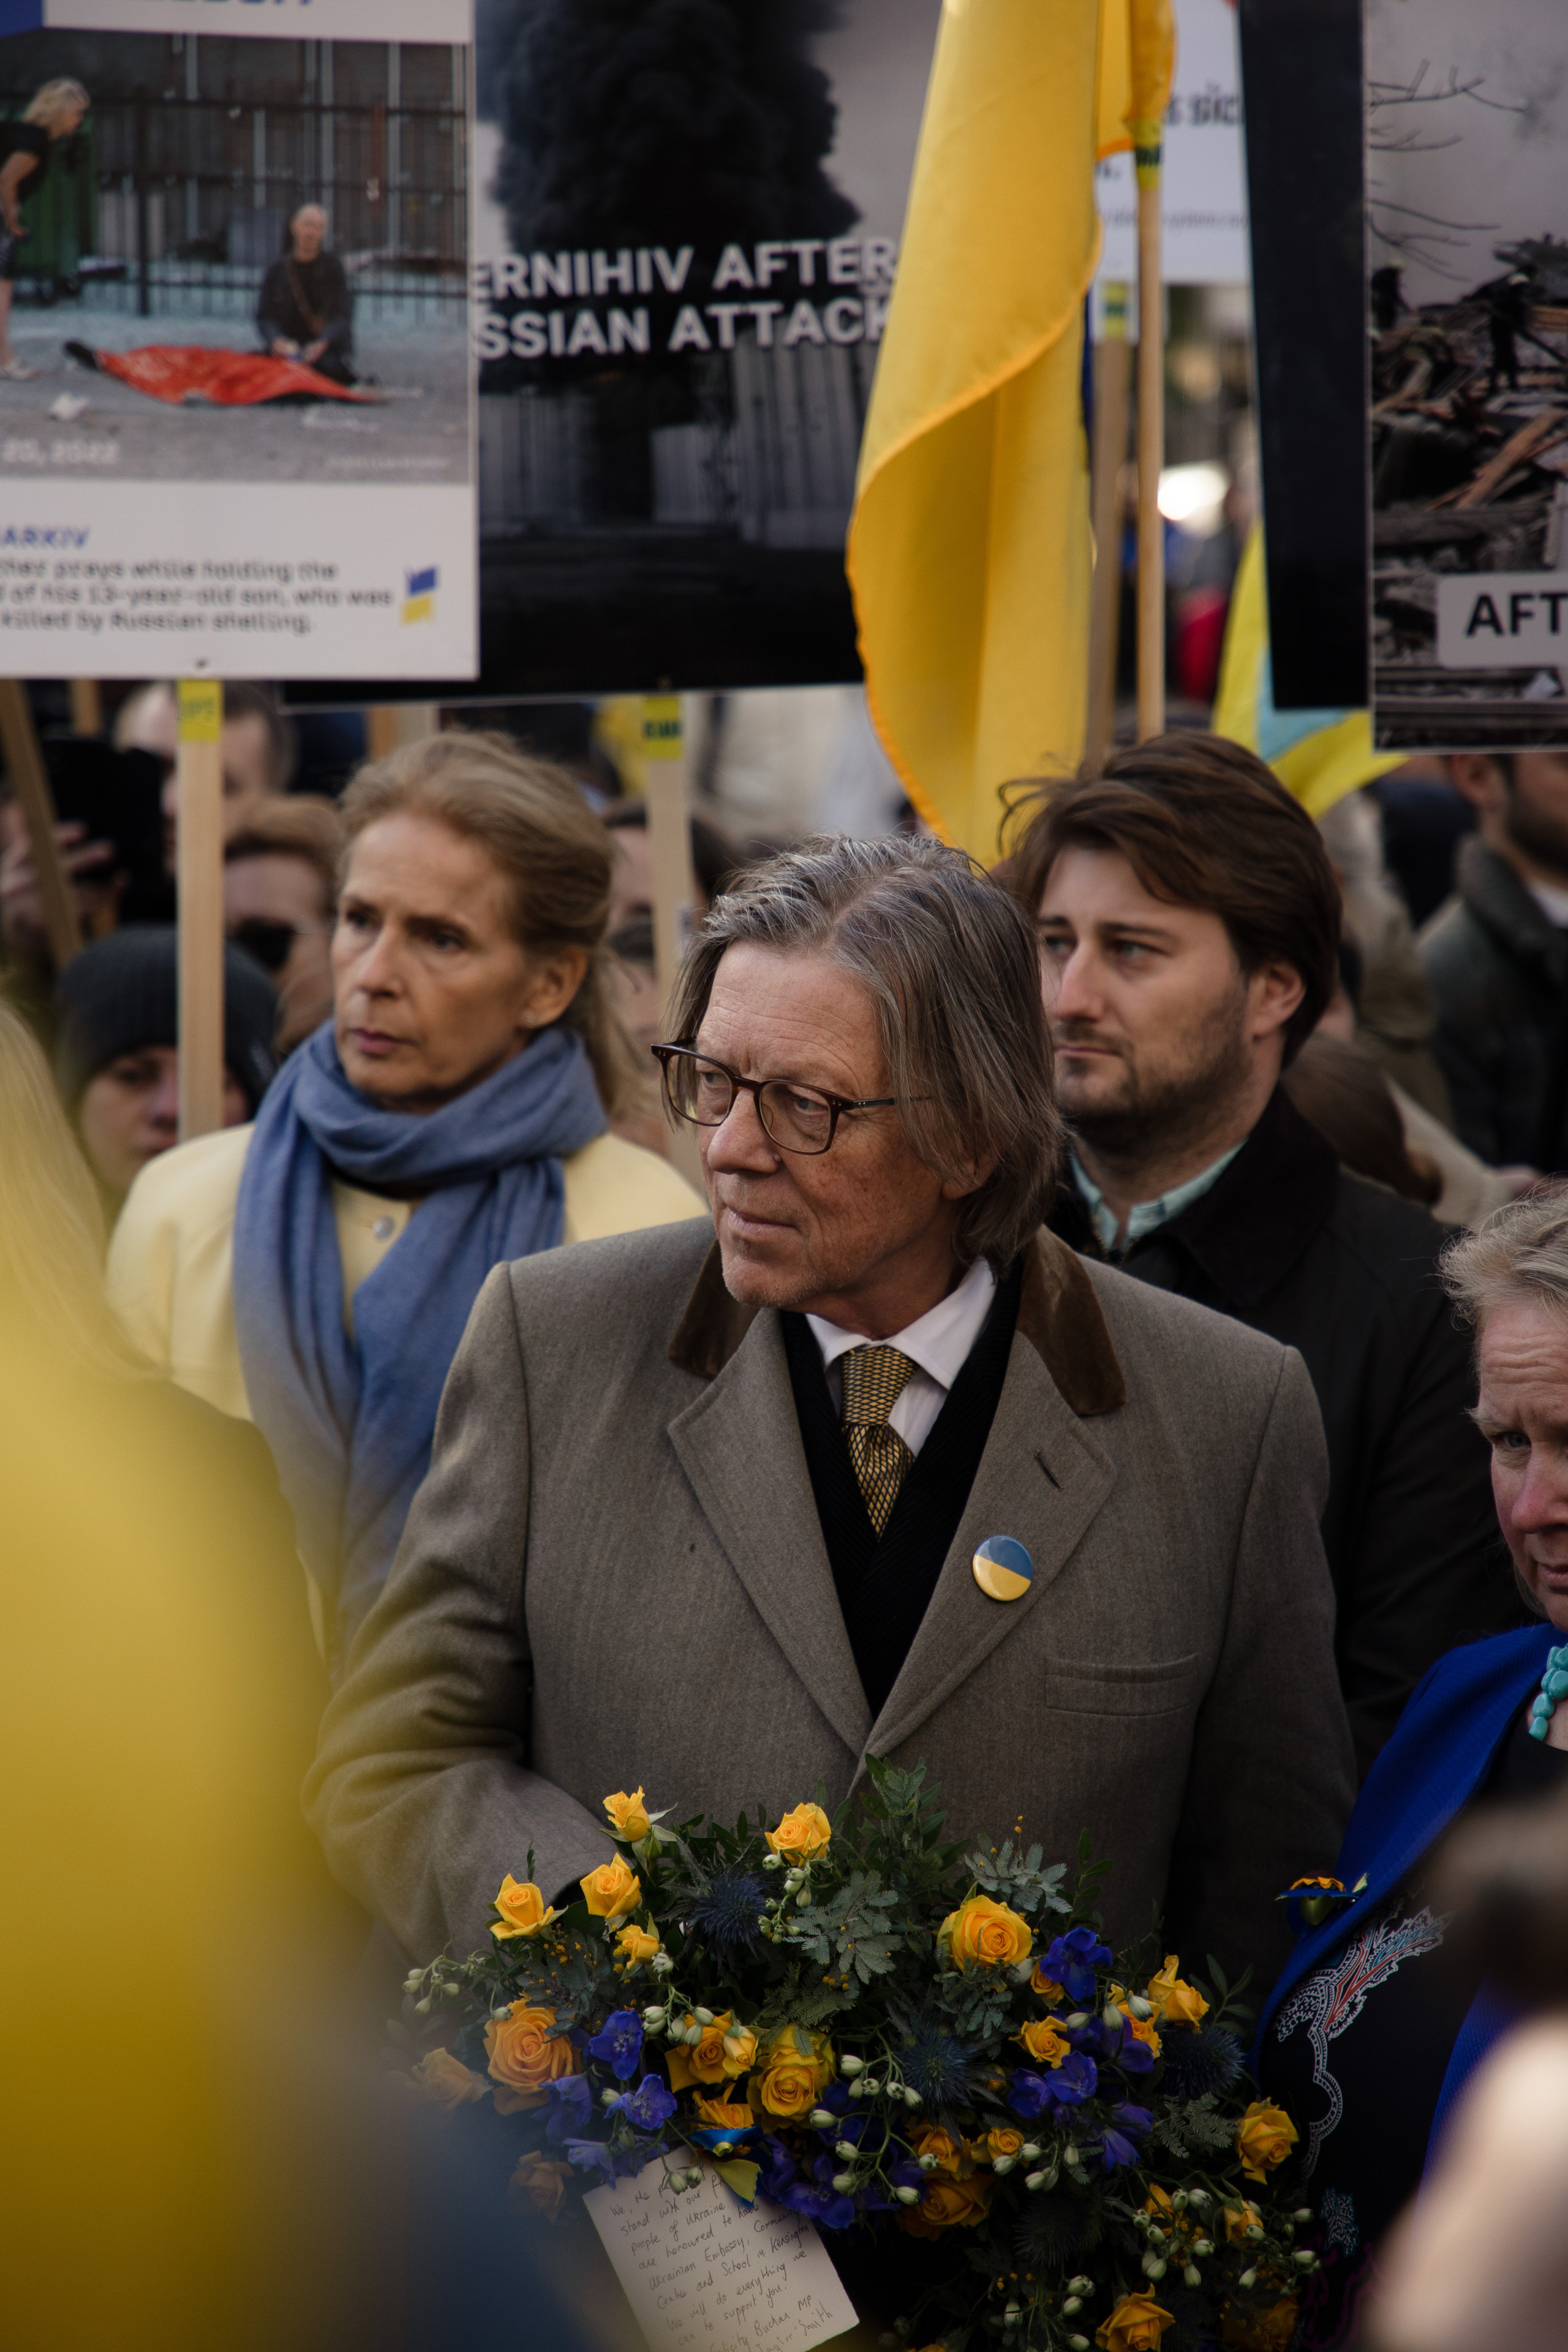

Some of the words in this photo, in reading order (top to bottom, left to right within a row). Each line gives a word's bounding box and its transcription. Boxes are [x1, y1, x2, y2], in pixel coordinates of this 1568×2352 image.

[712, 238, 898, 290] AFTER
[476, 307, 650, 360] SSIAN
[669, 296, 891, 352] ATTACK
[0, 559, 47, 577] her
[1466, 590, 1568, 637] AFT
[620, 2212, 650, 2236] stand
[659, 2198, 679, 2218] with
[686, 2190, 701, 2205] our
[631, 2233, 661, 2257] people
[669, 2220, 679, 2242] of
[639, 2258, 657, 2270] are
[666, 2223, 715, 2258] honoured
[723, 2215, 732, 2228] to
[649, 2262, 697, 2291] Ukrainian
[704, 2238, 750, 2263] Embassy,
[690, 2302, 706, 2319] will
[717, 2292, 727, 2305] do
[736, 2263, 787, 2296] everything
[793, 2250, 807, 2262] we
[696, 2271, 714, 2291] and
[722, 2254, 752, 2276] School
[758, 2249, 766, 2259] in
[678, 2334, 696, 2346] can
[704, 2319, 714, 2331] to
[724, 2294, 756, 2326] support
[766, 2285, 788, 2309] you.
[709, 2332, 751, 2352] Flicity
[754, 2312, 790, 2337] Buchan
[797, 2294, 812, 2312] MP
